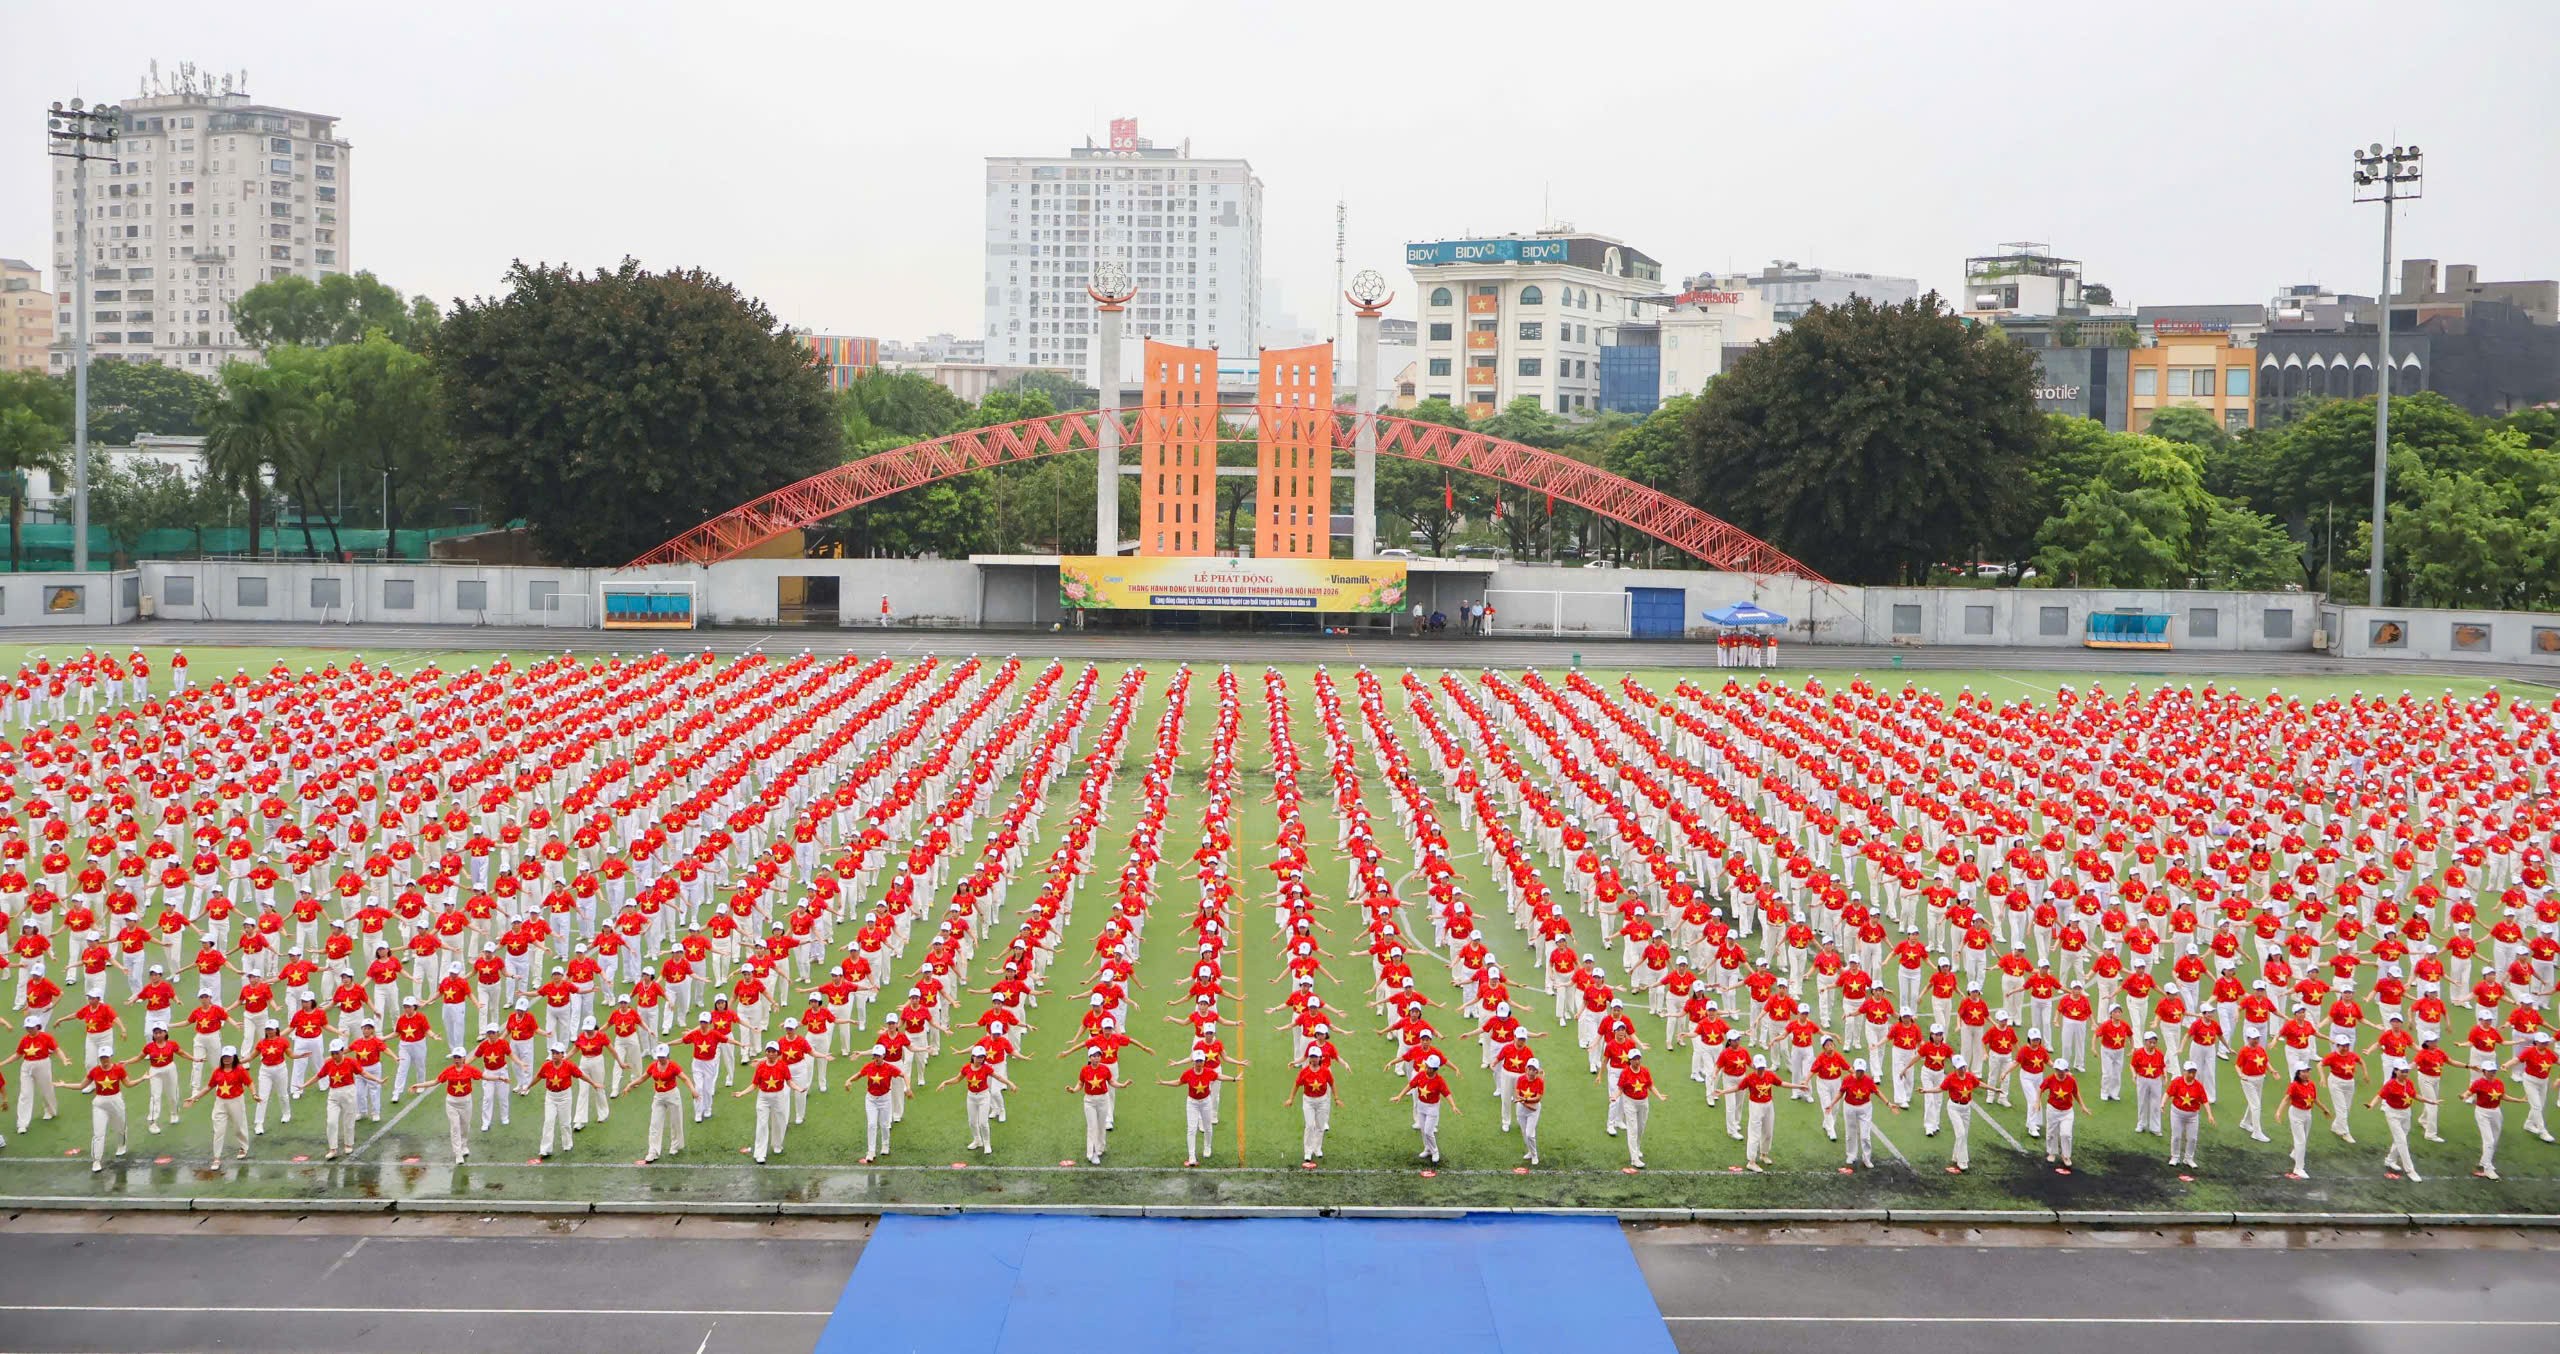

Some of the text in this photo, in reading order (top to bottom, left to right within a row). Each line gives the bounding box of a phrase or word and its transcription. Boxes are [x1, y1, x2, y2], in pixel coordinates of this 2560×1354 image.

[1114, 137, 1133, 148] 36
[1408, 249, 1434, 261] BIDV
[1455, 246, 1485, 259] BIDV
[1522, 246, 1550, 258] BIDV
[2030, 384, 2078, 400] urotile
[1331, 575, 1370, 585] Vinamilk
[1323, 587, 1339, 595] 2026
